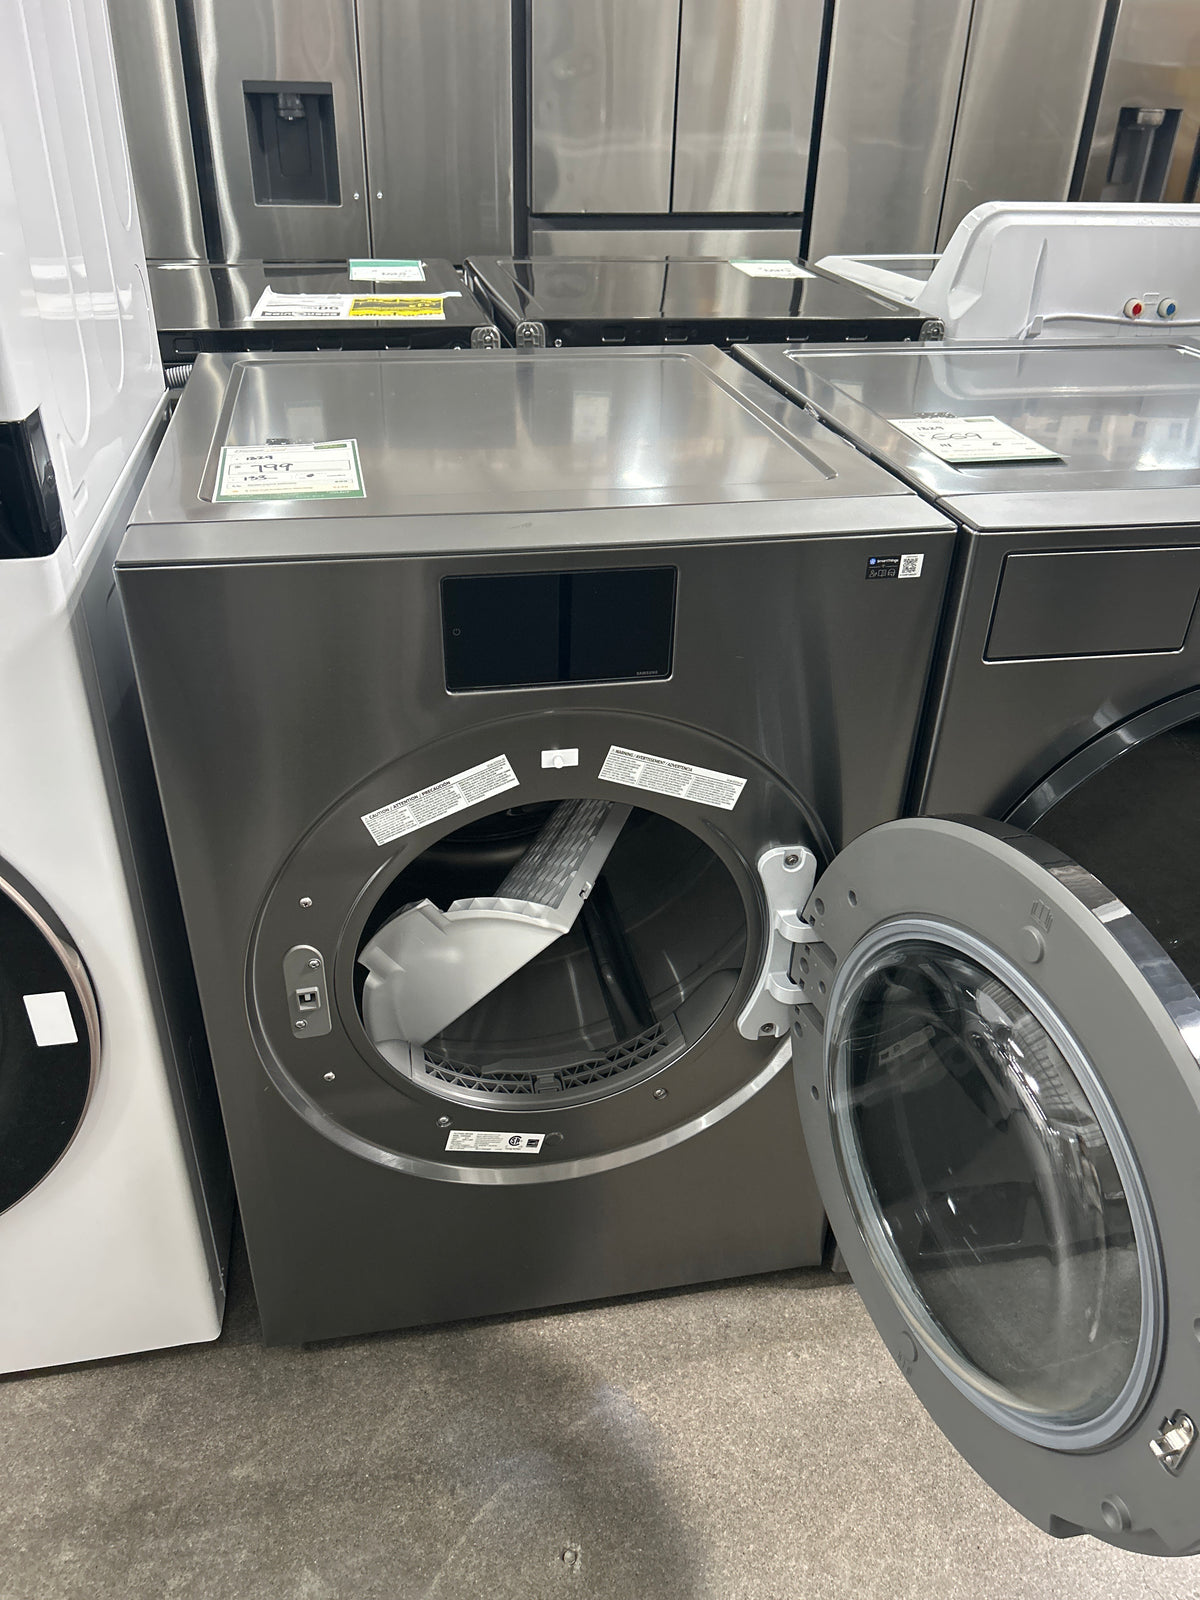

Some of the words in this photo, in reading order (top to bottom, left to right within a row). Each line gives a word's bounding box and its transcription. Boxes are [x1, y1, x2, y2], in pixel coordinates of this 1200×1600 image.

[931, 432, 982, 440] 669
[250, 462, 294, 473] 799
[368, 808, 390, 820] CAUTION
[393, 794, 419, 809] ATTENTION
